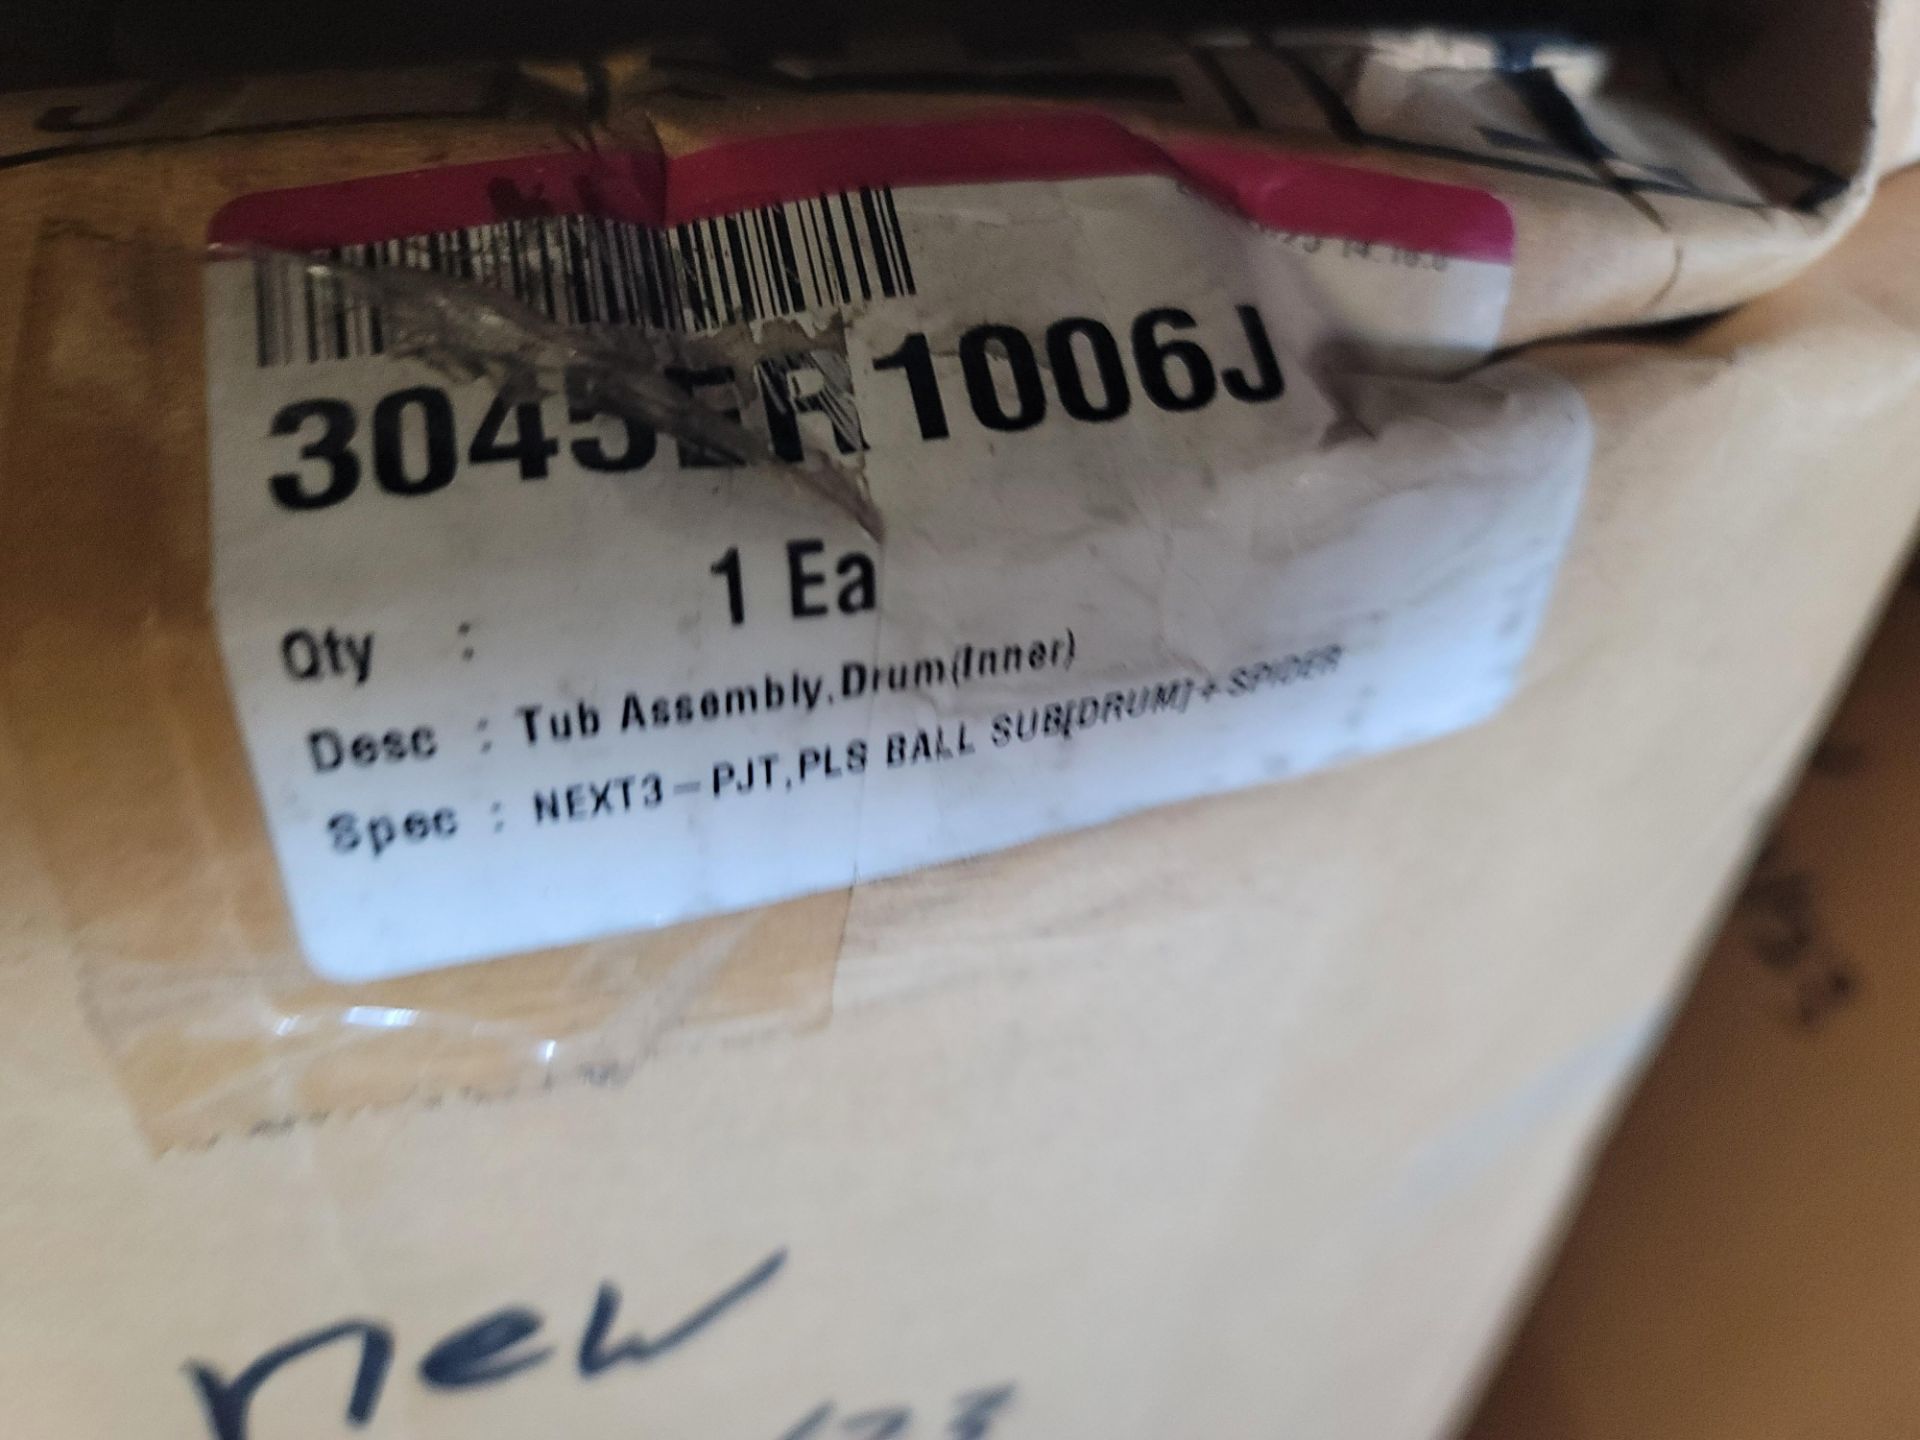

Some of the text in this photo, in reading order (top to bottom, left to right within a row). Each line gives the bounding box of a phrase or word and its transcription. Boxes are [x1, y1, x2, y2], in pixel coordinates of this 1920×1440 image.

[280, 628, 374, 687] Qty
[709, 546, 745, 625] 1
[786, 537, 877, 619] Ea
[307, 724, 440, 774] Desc
[518, 705, 602, 746] Tub
[326, 807, 459, 858] Spec
[885, 726, 976, 770] BALL
[182, 1246, 789, 1440] new
